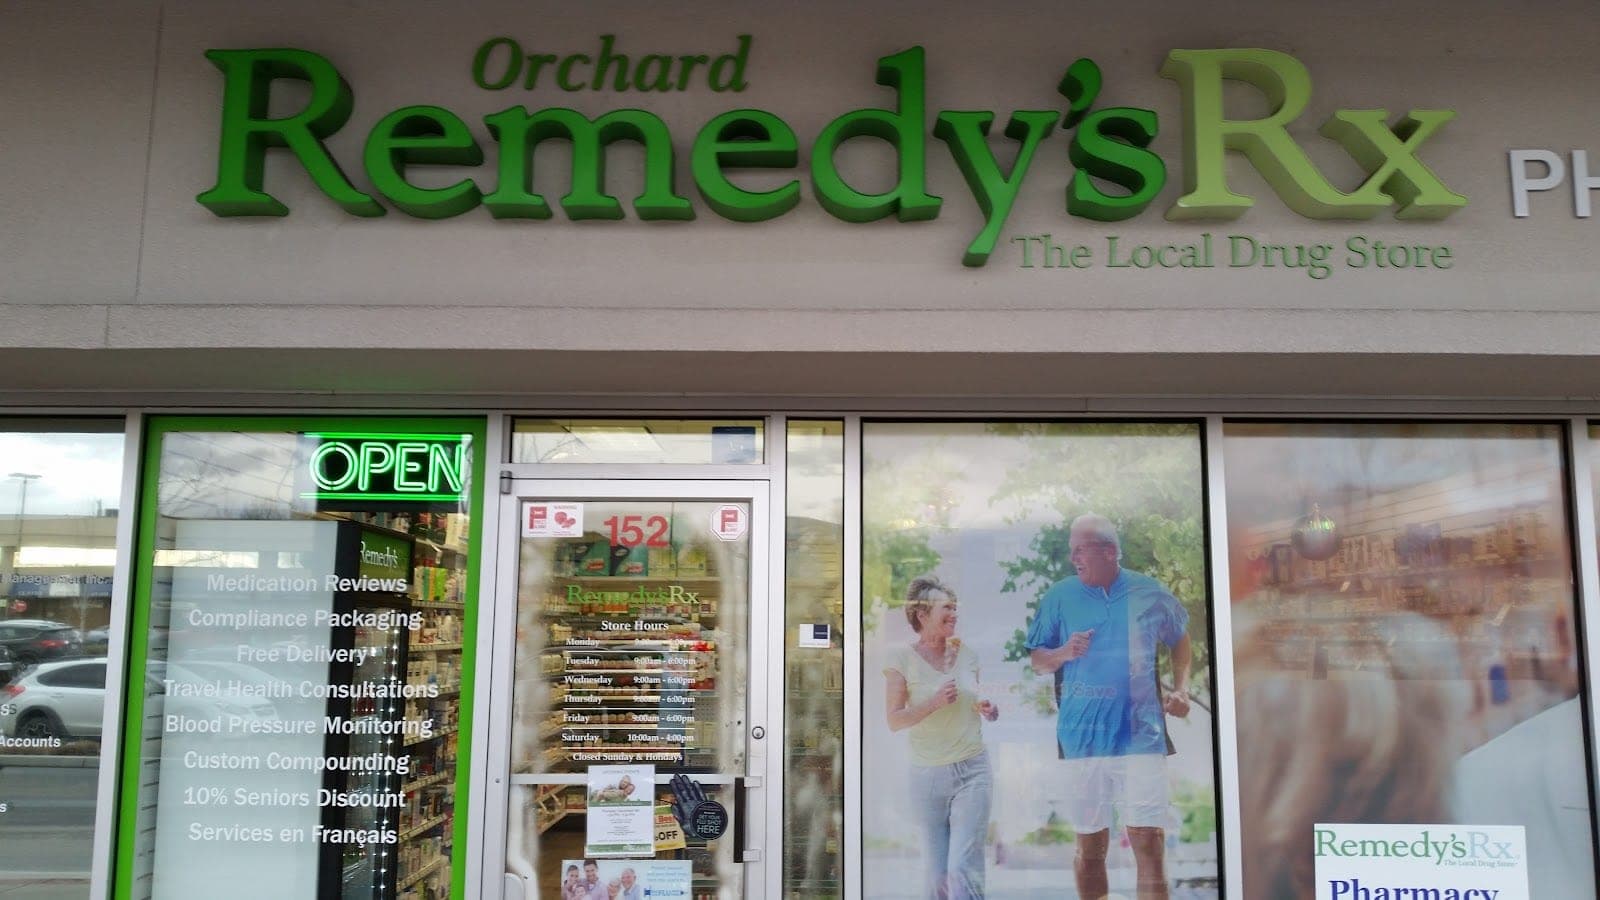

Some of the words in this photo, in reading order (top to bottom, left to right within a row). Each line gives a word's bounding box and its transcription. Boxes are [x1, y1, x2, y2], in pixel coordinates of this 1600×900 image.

[472, 35, 752, 94] Orchard
[1010, 235, 1093, 270] The
[1105, 234, 1214, 270] Local
[1228, 235, 1334, 279] Drug
[1345, 236, 1452, 270] Store
[309, 441, 465, 493] OPEN
[604, 515, 669, 548] 152
[207, 574, 317, 592] Medication
[324, 574, 408, 592] Reviews
[189, 609, 307, 630] Compliance
[315, 609, 422, 631] Packaging
[601, 620, 631, 631] Store
[634, 620, 669, 631] Hours
[565, 639, 600, 648] Monday
[237, 646, 280, 662] Free
[286, 646, 367, 666] Delivery
[565, 657, 600, 667] Tuesday
[634, 657, 661, 665] 9:00am
[667, 657, 696, 667] 6:00pm
[163, 680, 221, 698] Travel
[228, 680, 293, 698] Health
[301, 680, 439, 699] Consultations
[564, 676, 613, 686] Wednesday
[633, 676, 661, 684] 9:00am
[667, 676, 696, 686] 6:00pm
[564, 695, 603, 705] Thursday
[666, 695, 695, 705] 6:00pm
[166, 715, 221, 734] Blood
[228, 716, 316, 734] Pressure
[323, 716, 433, 738] Monitoring
[562, 714, 590, 723] Friday
[666, 714, 695, 724] 6:00pm
[0, 736, 61, 748] Accounts
[561, 733, 600, 743] Saturday
[627, 733, 659, 742] 10:00am
[666, 733, 694, 743] 4:00pm
[184, 750, 260, 770] Custom
[266, 751, 410, 775] Compounding
[572, 752, 600, 761] Closed
[602, 752, 634, 763] Sunday
[183, 786, 228, 806] 10%
[234, 787, 310, 806] Seniors
[316, 789, 406, 808] Discount
[189, 822, 273, 842] Services
[280, 827, 303, 842] en
[312, 825, 397, 849] Français
[697, 825, 721, 834] HERE
